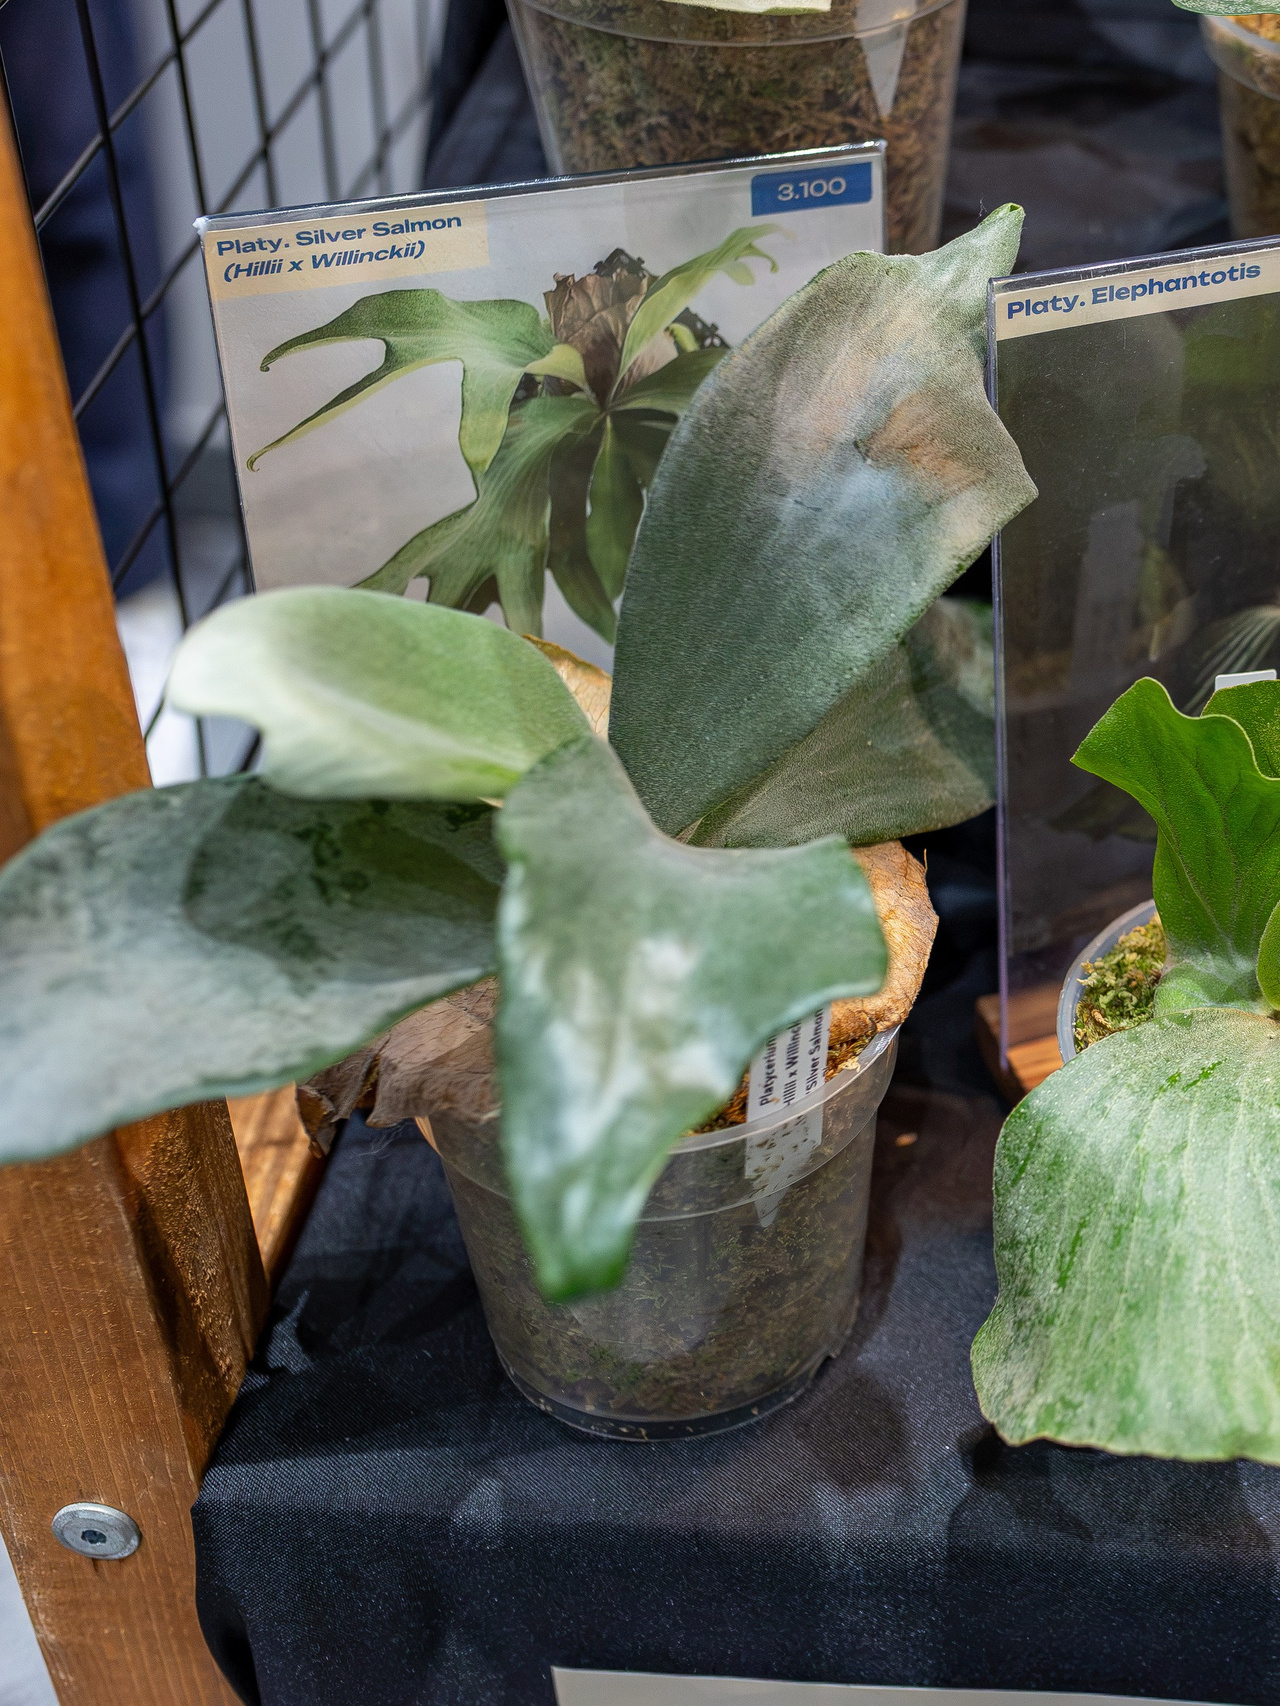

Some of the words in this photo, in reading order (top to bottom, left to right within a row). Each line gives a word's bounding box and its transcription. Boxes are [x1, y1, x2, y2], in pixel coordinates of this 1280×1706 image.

[777, 176, 847, 202] 3.100
[216, 238, 290, 257] Platy.
[295, 228, 367, 248] Silver
[372, 215, 463, 237] Salmon
[223, 257, 284, 283] (Hillii
[287, 259, 304, 273] x
[311, 240, 426, 270] Willinckii)
[1007, 294, 1085, 320] Platy.
[1091, 262, 1262, 305] Elephantotis
[788, 1069, 798, 1078] x
